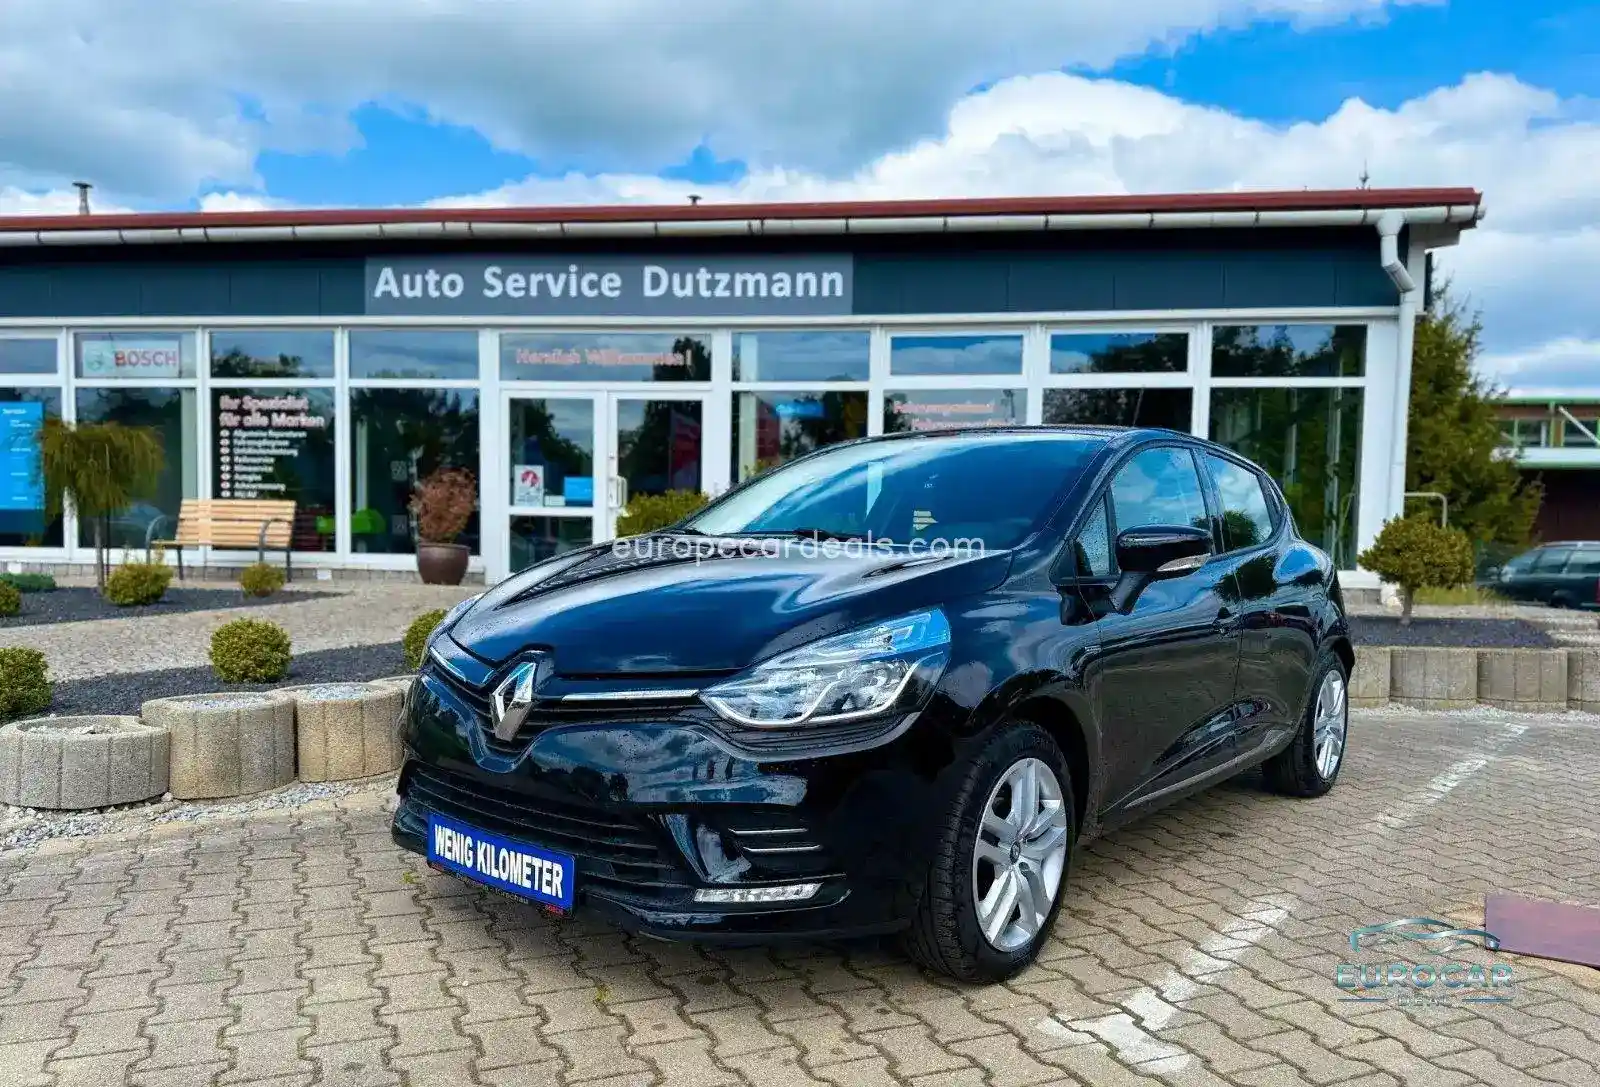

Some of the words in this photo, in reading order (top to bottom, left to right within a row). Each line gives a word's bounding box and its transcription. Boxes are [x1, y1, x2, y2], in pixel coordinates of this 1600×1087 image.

[374, 267, 464, 298] Auto
[483, 265, 622, 298] Service
[643, 265, 844, 298] Dutzmann
[114, 350, 177, 367] BOSCH
[434, 823, 474, 869] WENIG
[476, 840, 564, 899] KILOMETER
